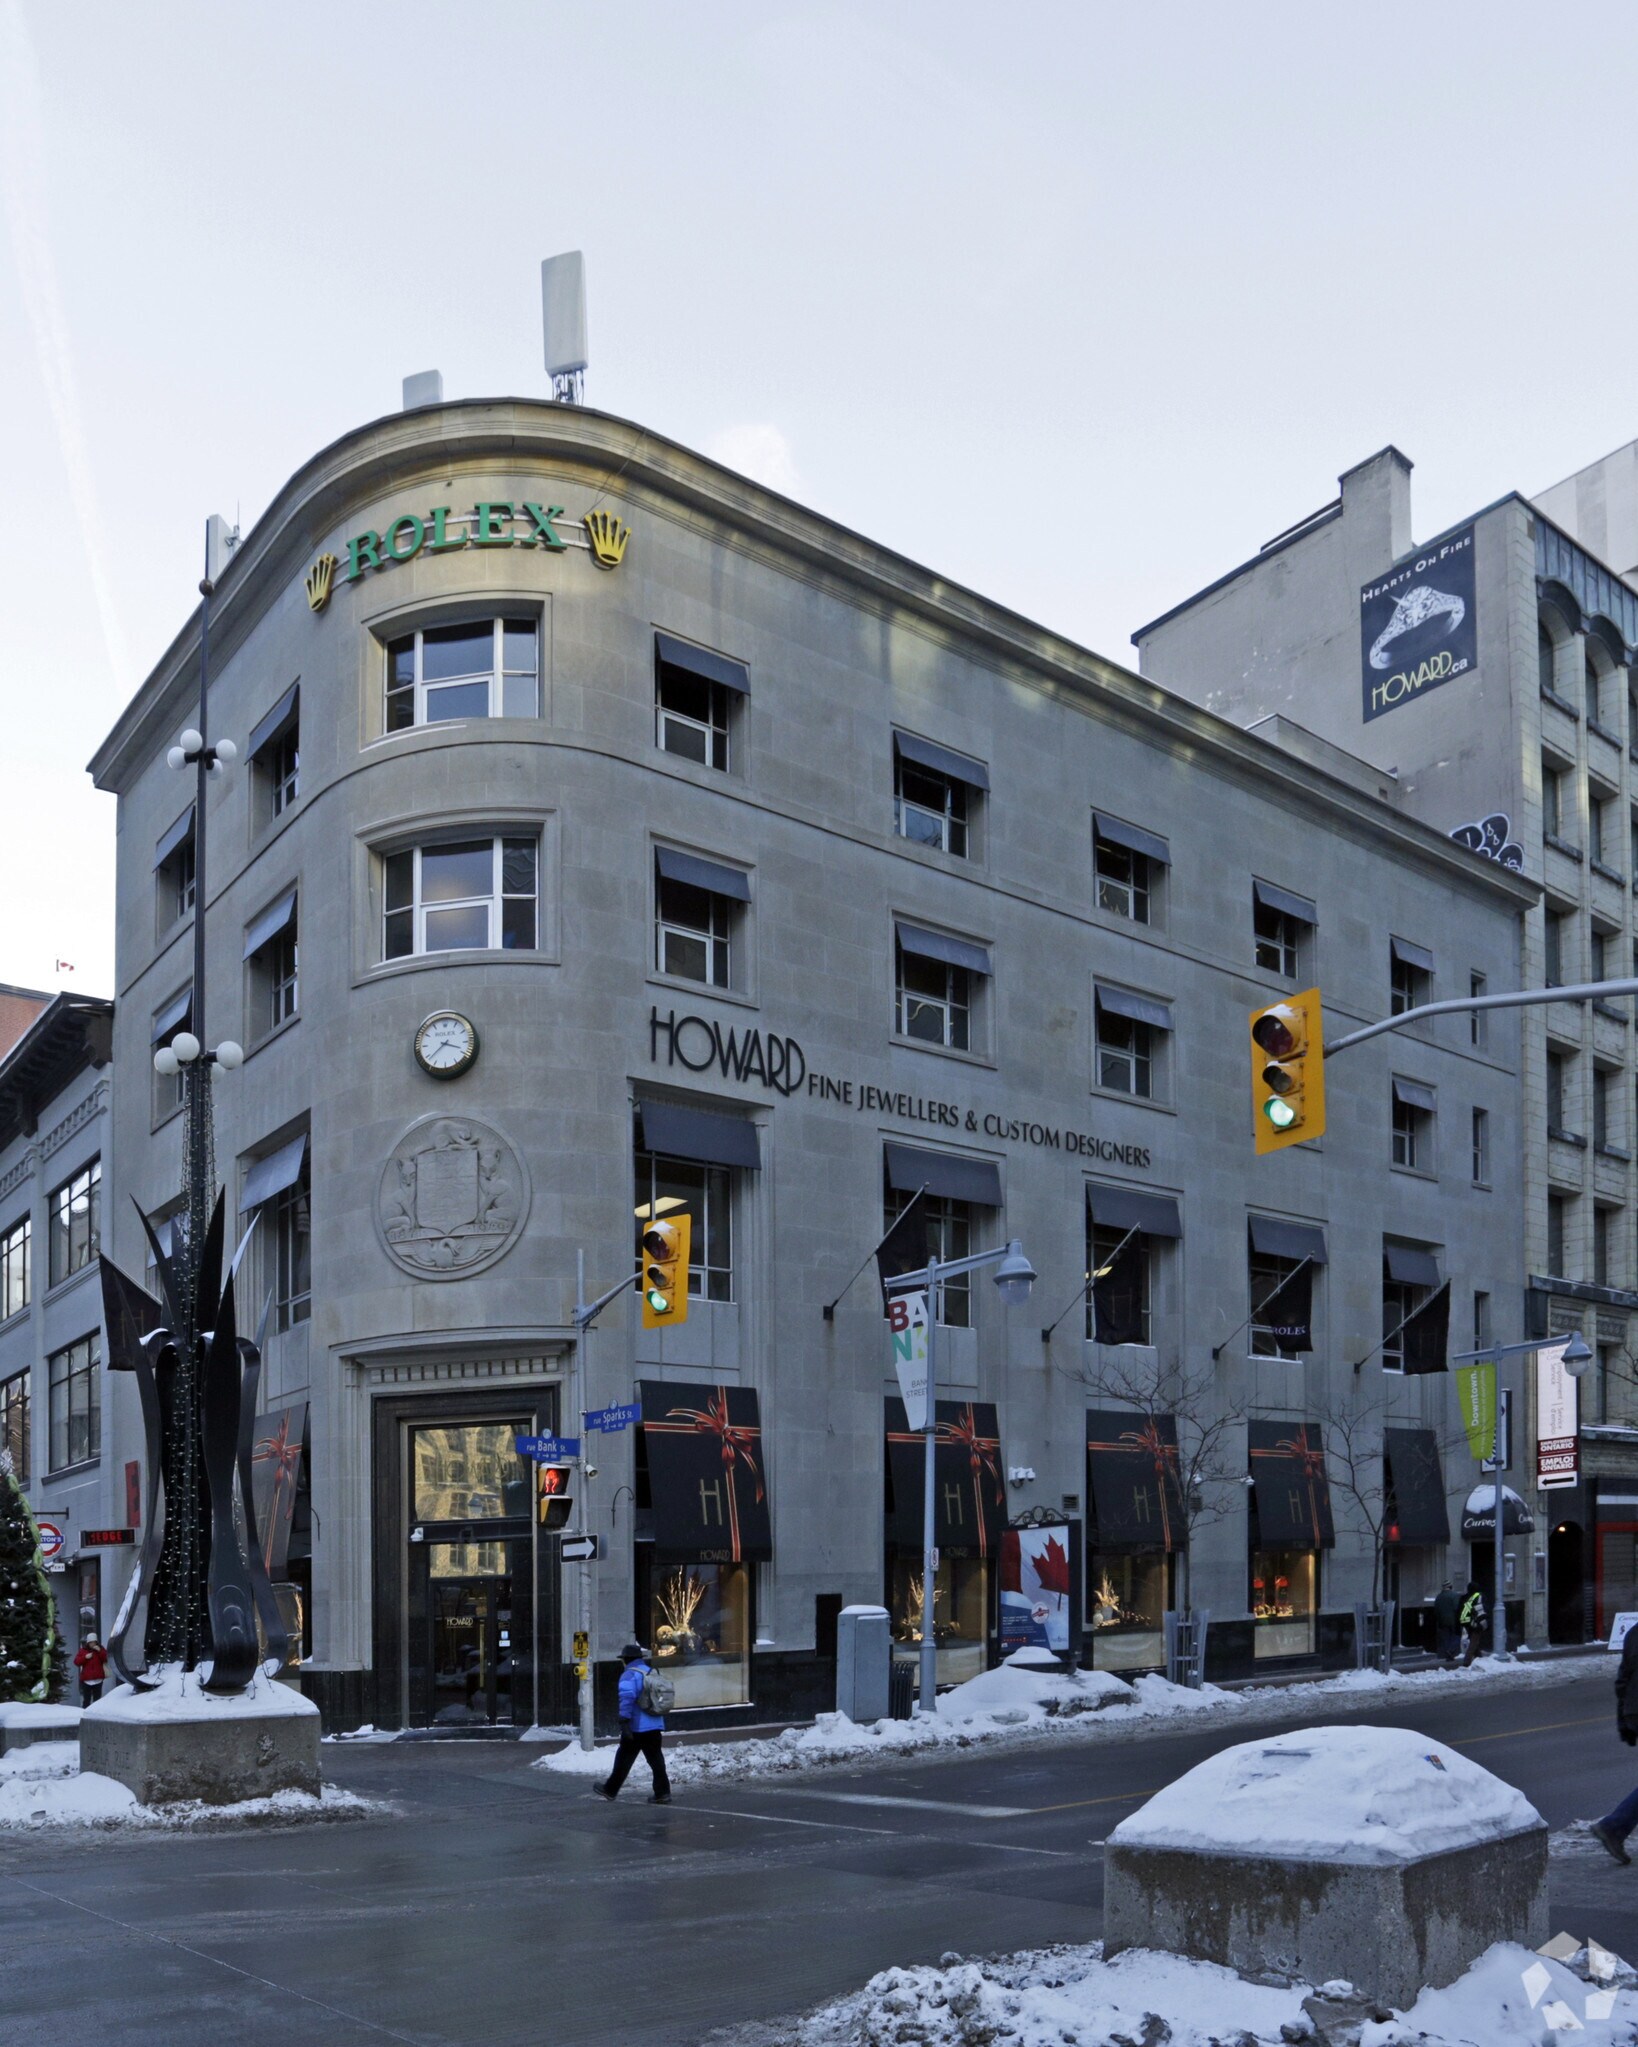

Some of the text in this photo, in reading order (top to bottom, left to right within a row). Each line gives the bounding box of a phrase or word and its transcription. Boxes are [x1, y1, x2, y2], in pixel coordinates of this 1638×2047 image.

[346, 501, 567, 583] ROLEX
[1362, 536, 1471, 603] HEARTS ON FIRE
[651, 1005, 1151, 1168] HOWARD FINE JEWELLERS & CUSTOM DESIGNERS
[911, 1379, 928, 1389] BAN
[906, 1388, 927, 1399] STREE
[603, 1408, 626, 1426] Sparks
[526, 1444, 536, 1452] rue
[537, 1440, 557, 1452] Bank
[1540, 1442, 1574, 1452] ONTARIO
[1540, 1456, 1574, 1466] EMPLOI
[1540, 1463, 1574, 1472] ONTARIO
[700, 1478, 722, 1526] H
[945, 1483, 962, 1525] H
[1464, 1518, 1497, 1529] Curves
[700, 1549, 730, 1562] HOWARD
[446, 1617, 473, 1627] HOWARD
